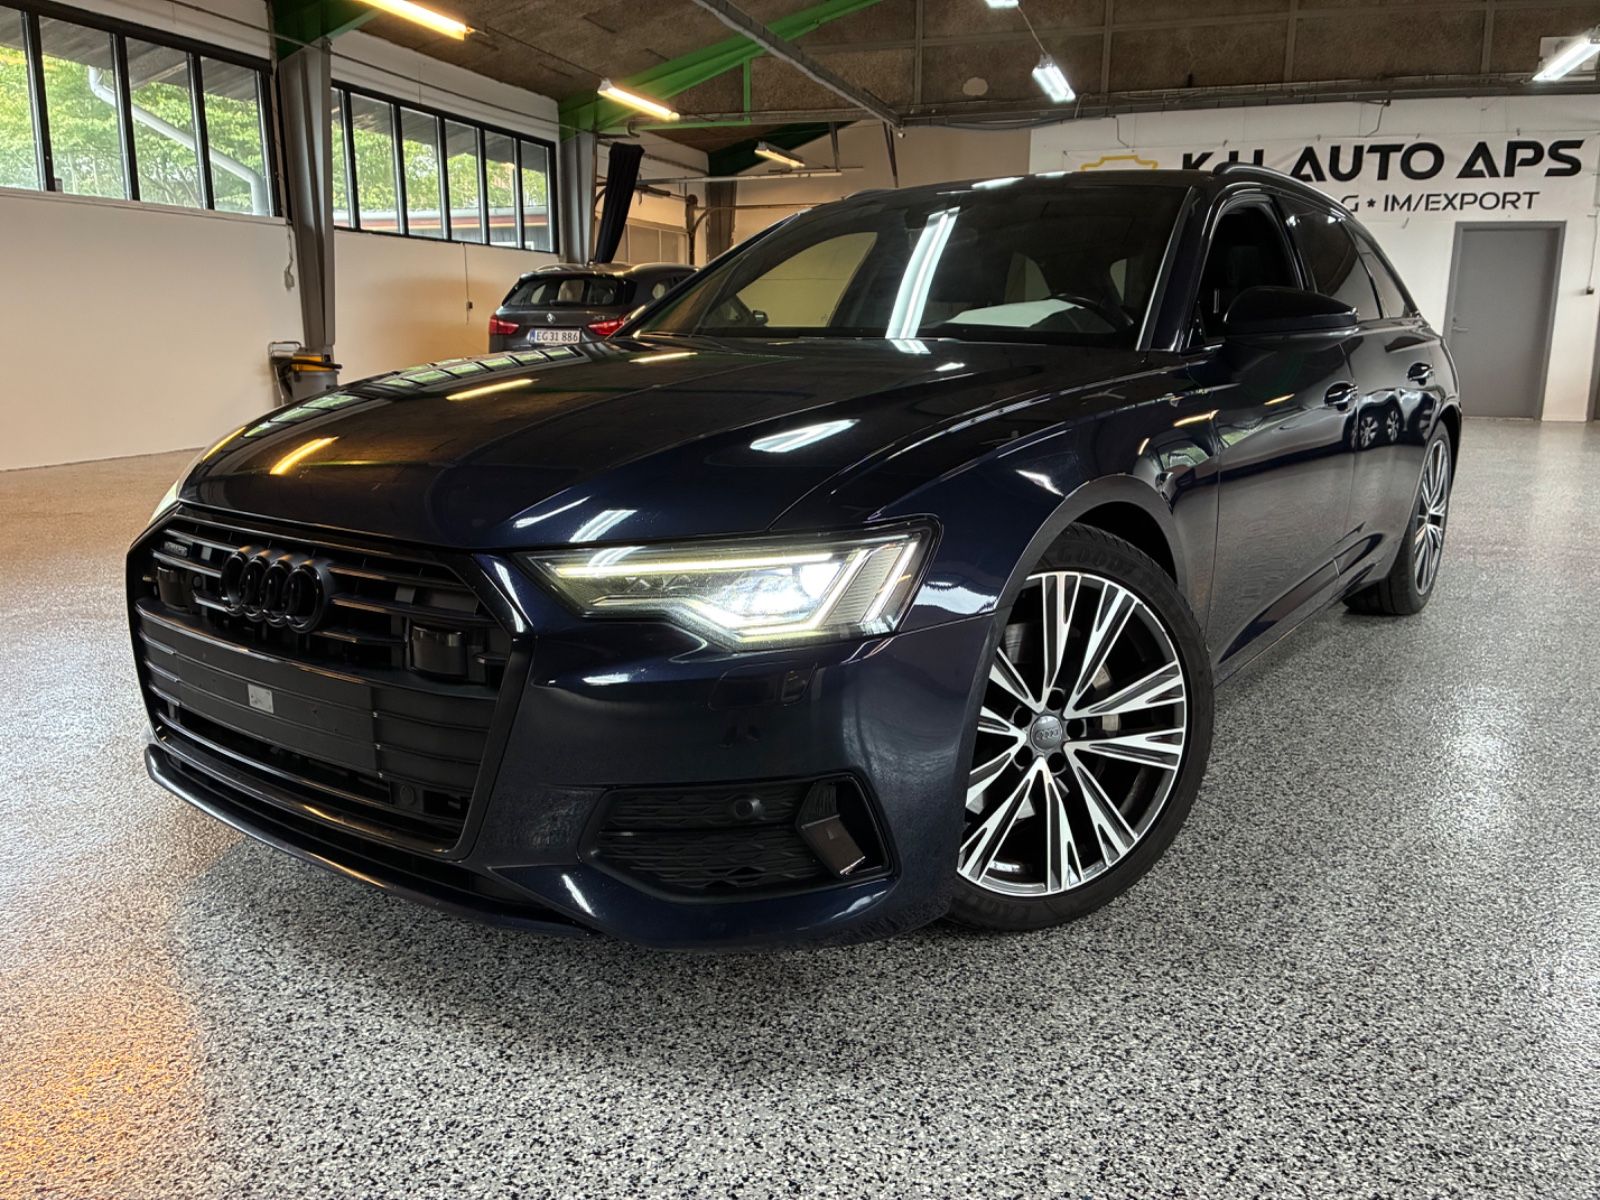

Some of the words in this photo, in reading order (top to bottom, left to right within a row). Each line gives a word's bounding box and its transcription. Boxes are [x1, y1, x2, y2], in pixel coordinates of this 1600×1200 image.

[1290, 142, 1445, 182] AUTO
[1456, 139, 1585, 179] APS
[1383, 191, 1540, 212] IM/EXPORT
[536, 332, 548, 341] EG
[549, 332, 559, 341] 31
[562, 332, 578, 342] 886
